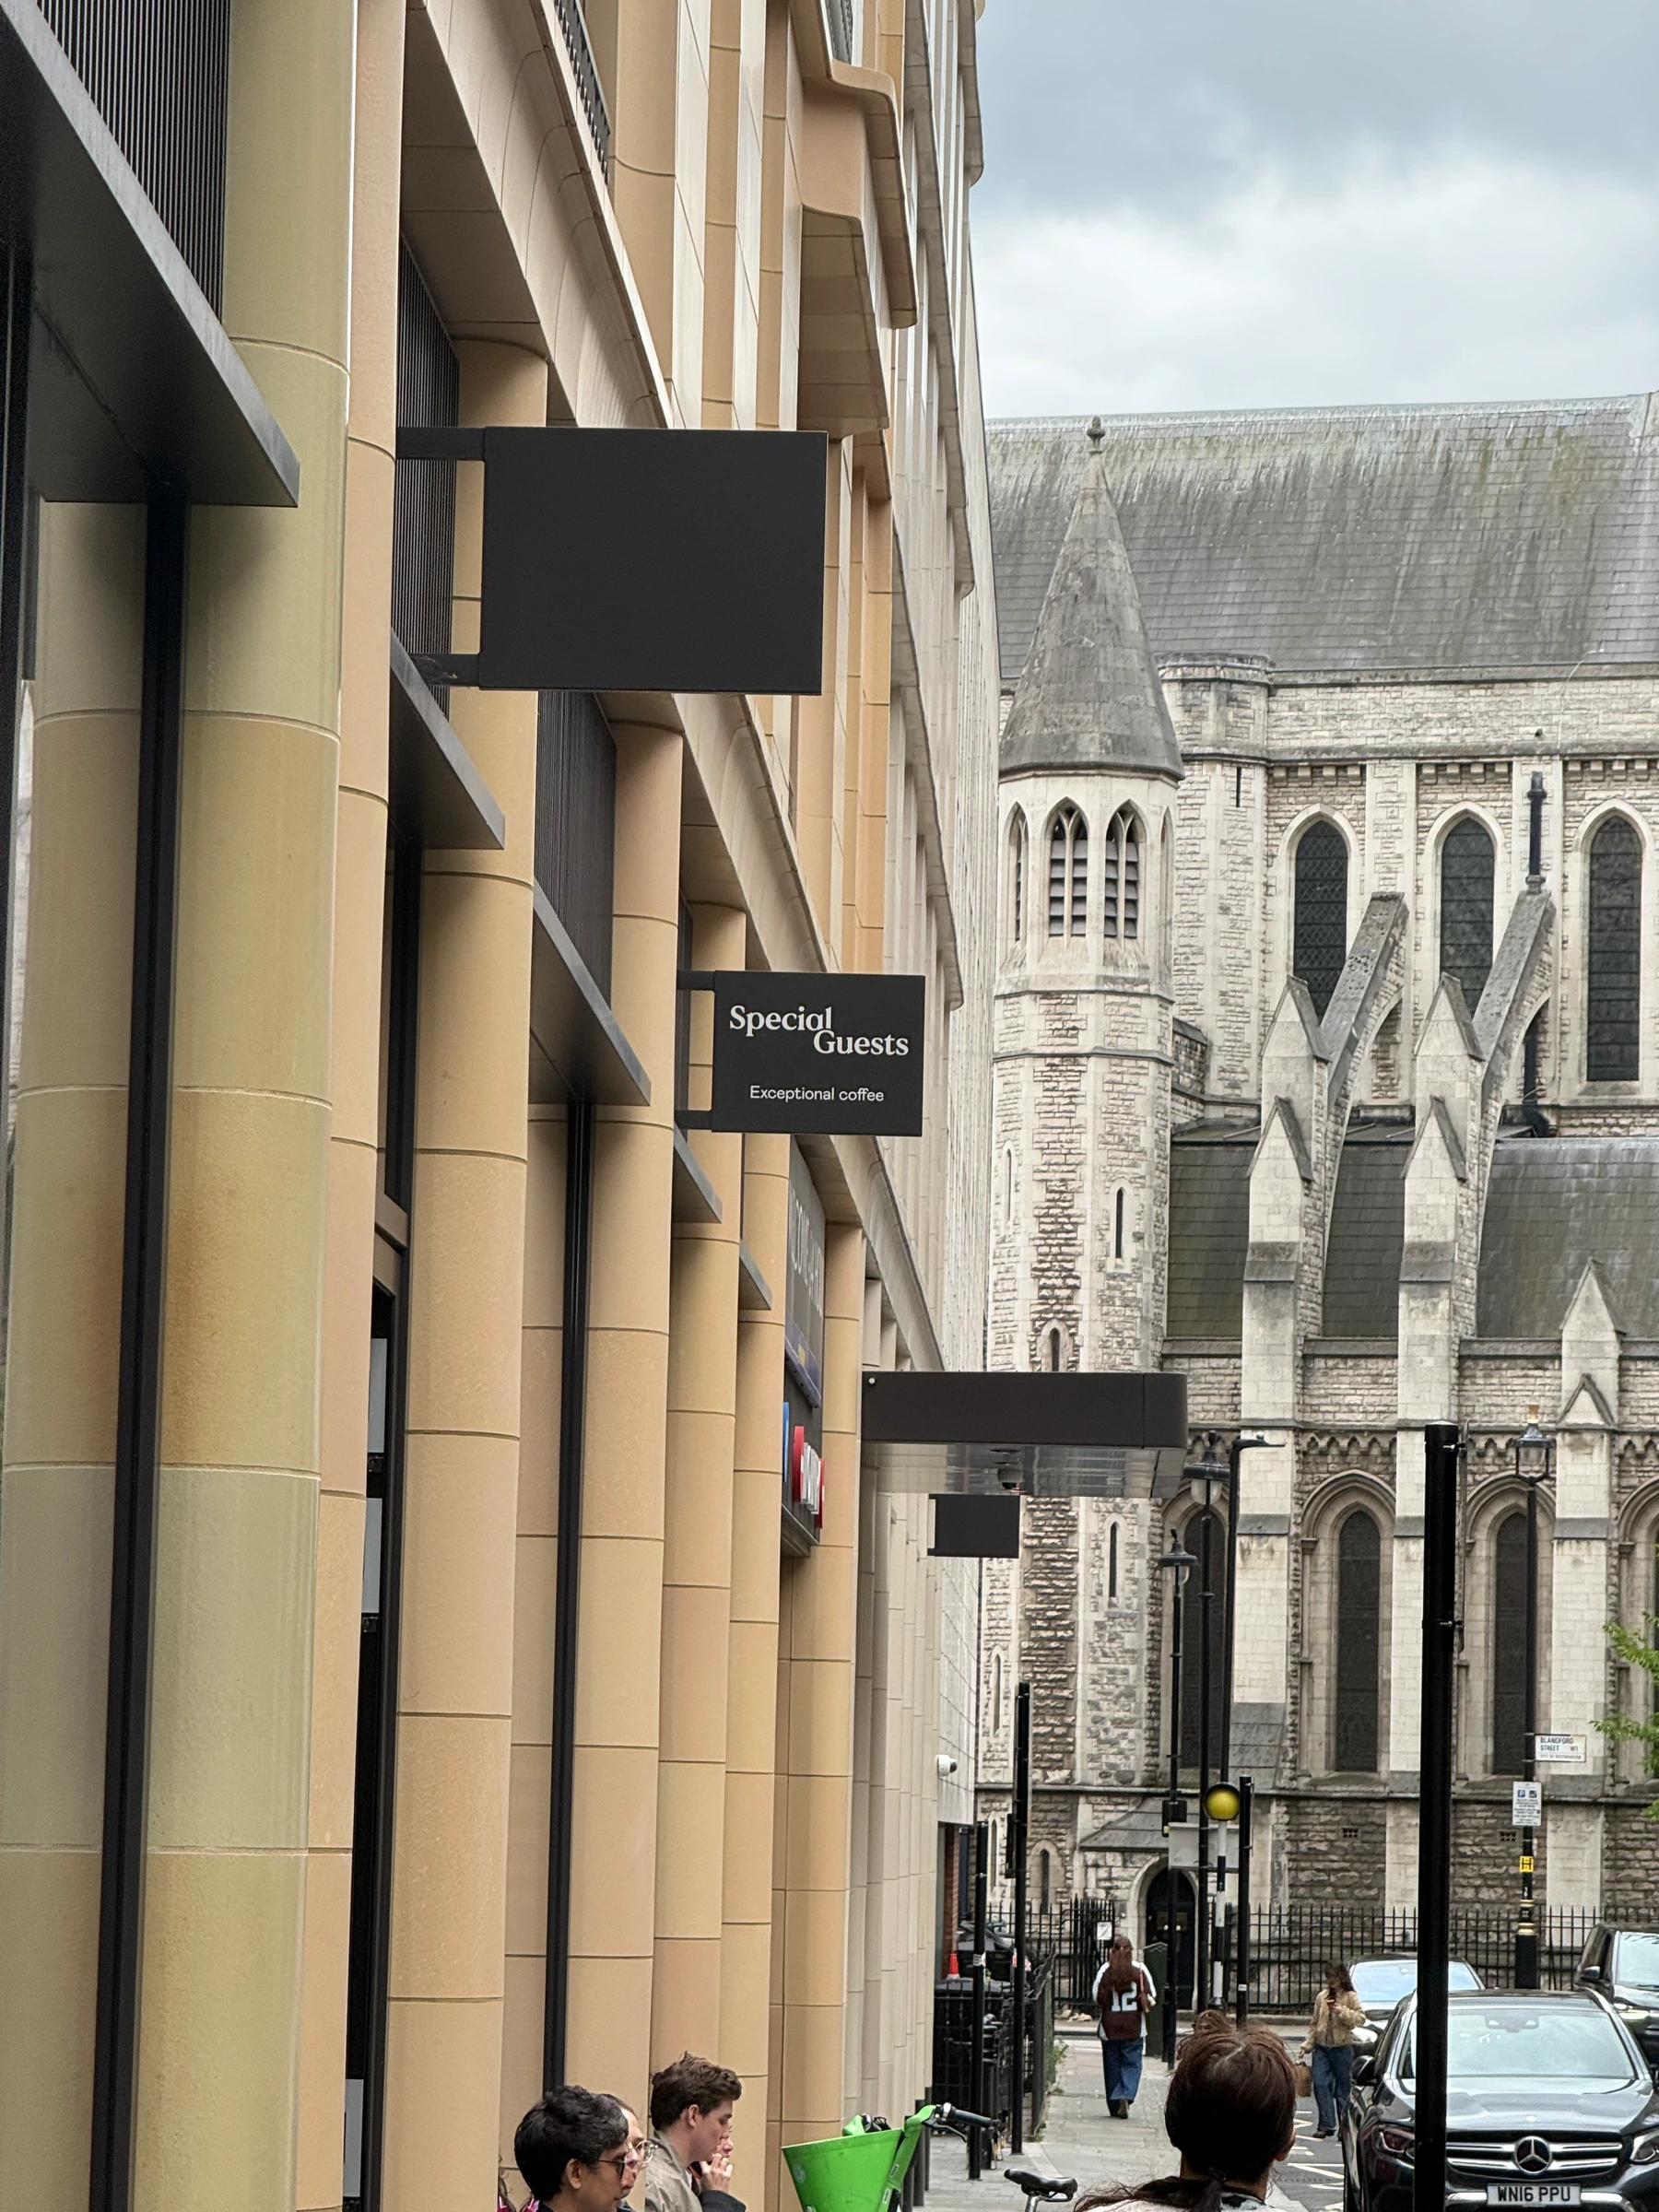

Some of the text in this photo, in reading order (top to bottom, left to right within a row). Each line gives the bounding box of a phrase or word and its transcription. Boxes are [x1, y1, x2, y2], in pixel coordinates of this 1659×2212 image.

[729, 1005, 832, 1037] Special
[813, 1030, 910, 1056] Guests
[749, 1085, 885, 1103] Exceptional coffee
[1521, 1857, 1532, 1870] H
[1111, 1982, 1138, 2012] 12
[1497, 2186, 1571, 2202] WN16 PPU
